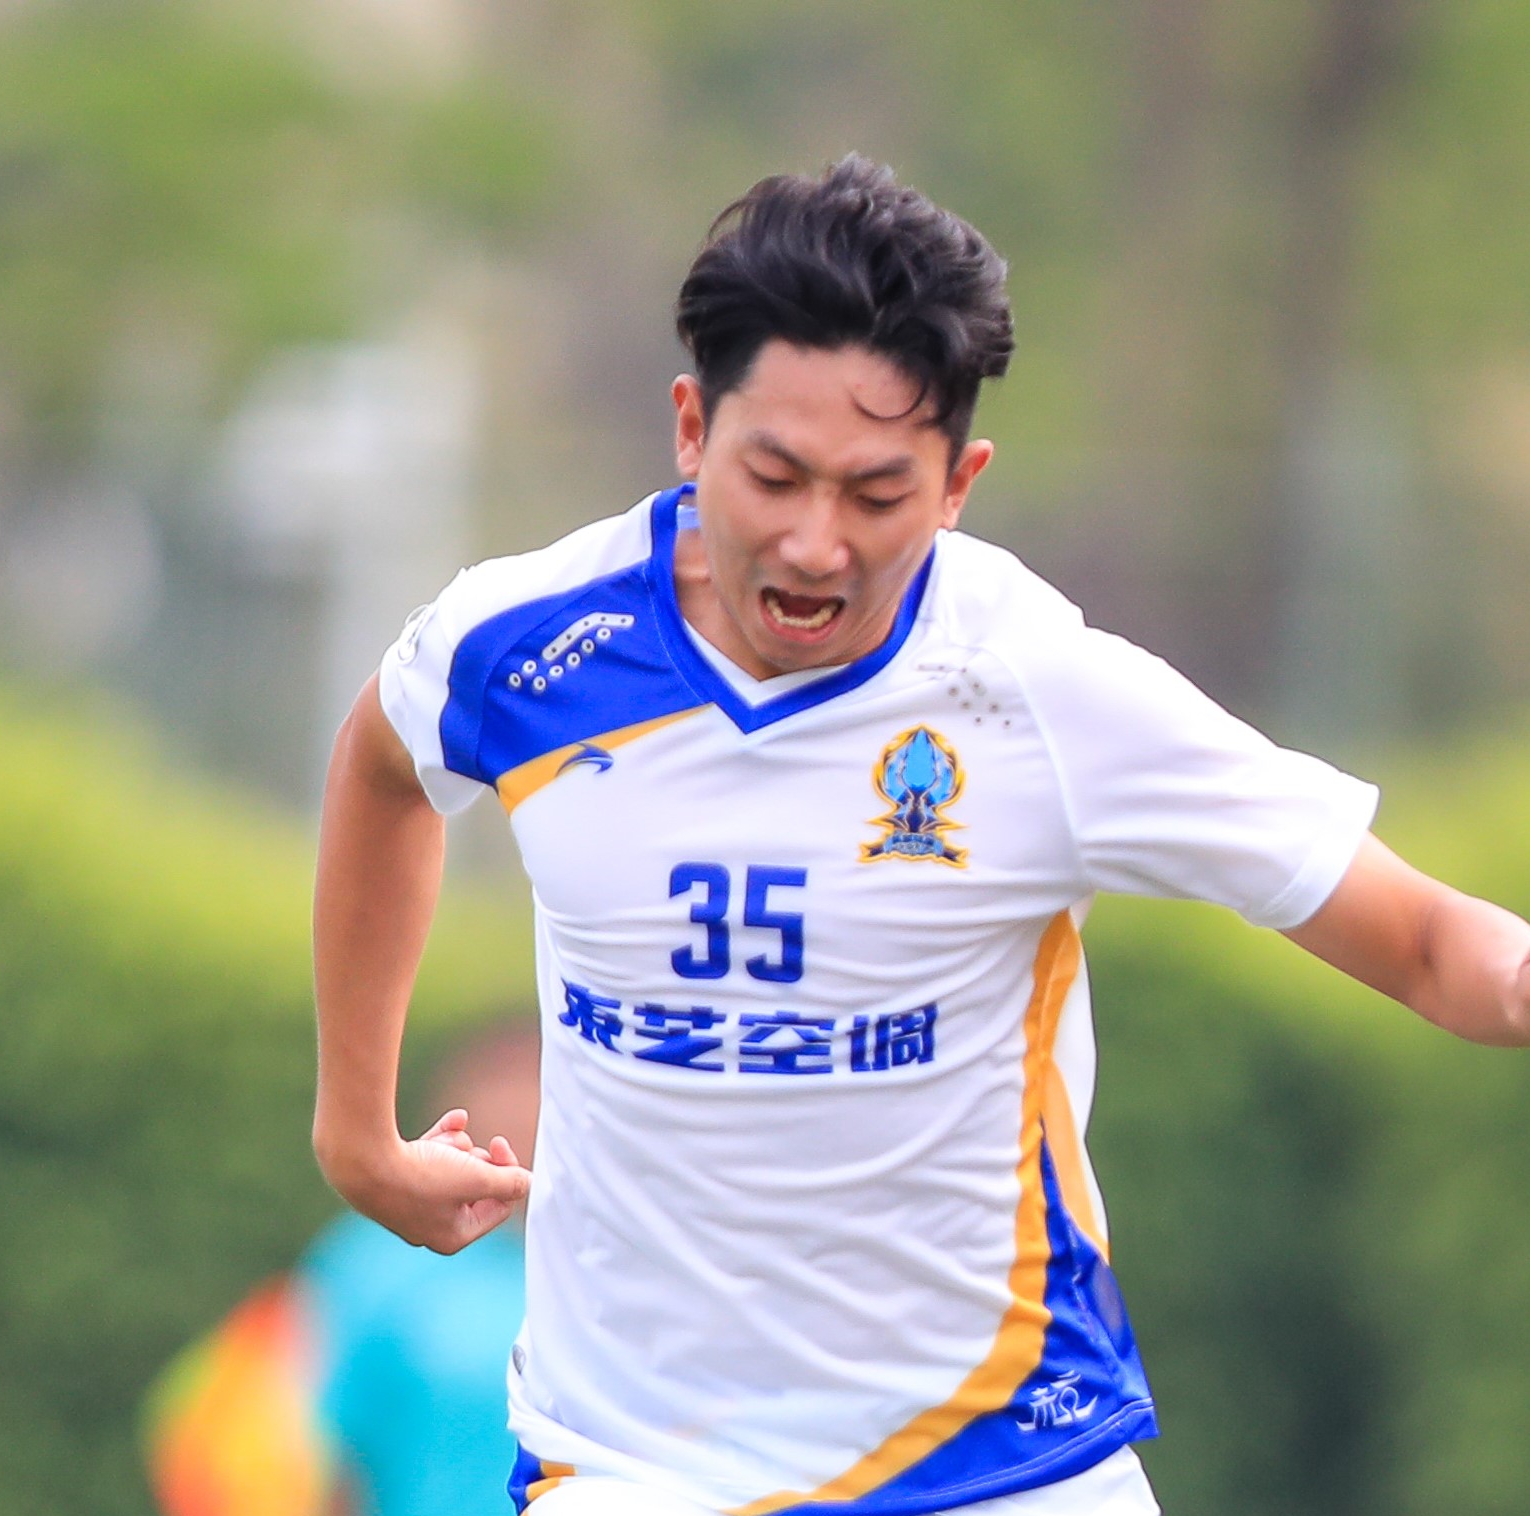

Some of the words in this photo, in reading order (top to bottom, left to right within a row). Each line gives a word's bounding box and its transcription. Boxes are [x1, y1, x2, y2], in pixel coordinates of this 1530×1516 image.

[668, 861, 809, 984] 35
[557, 975, 939, 1075] 东芝空调
